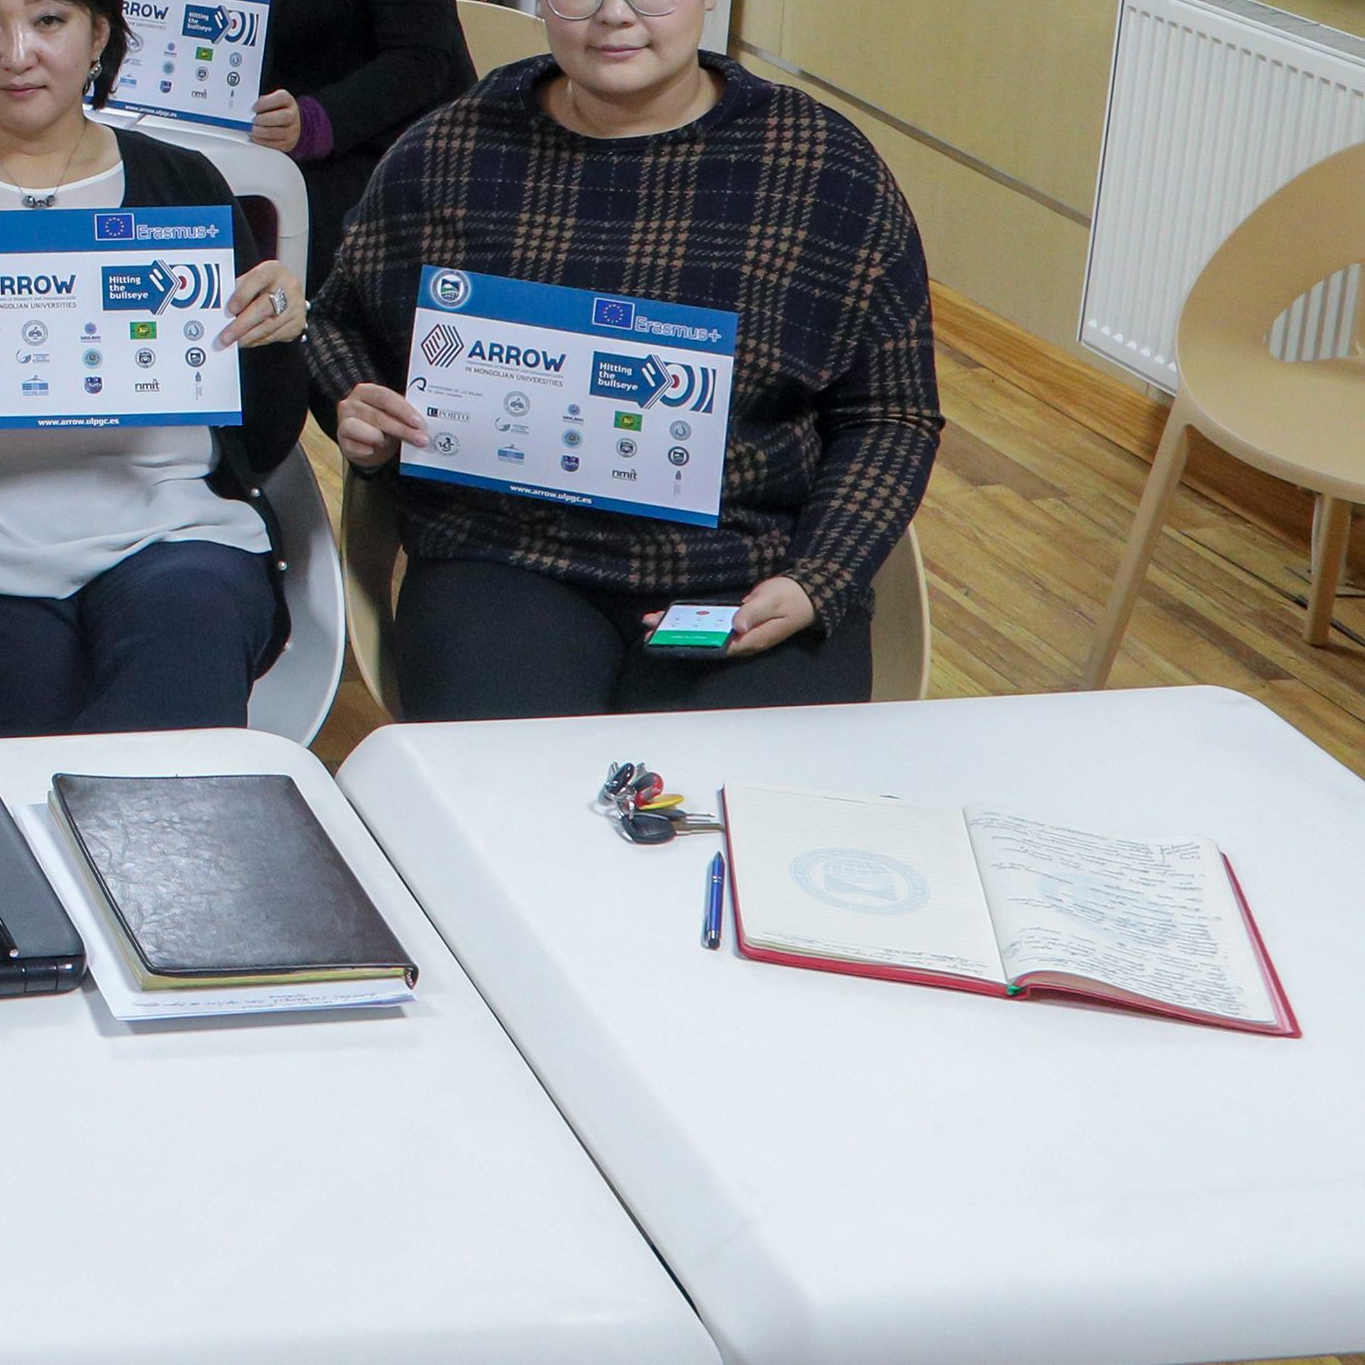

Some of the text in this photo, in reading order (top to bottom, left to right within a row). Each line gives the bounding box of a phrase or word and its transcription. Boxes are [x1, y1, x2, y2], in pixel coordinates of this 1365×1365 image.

[137, 225, 219, 240] Erasmus+
[109, 275, 141, 285] Hitting
[109, 291, 148, 300] bullseye
[635, 316, 721, 343] Erasmus+
[468, 340, 566, 372] ARROW
[599, 370, 615, 380] the
[600, 363, 632, 375] Hitting
[135, 379, 160, 391] nmit
[598, 378, 638, 391] bullseye
[612, 469, 637, 481] nmit
